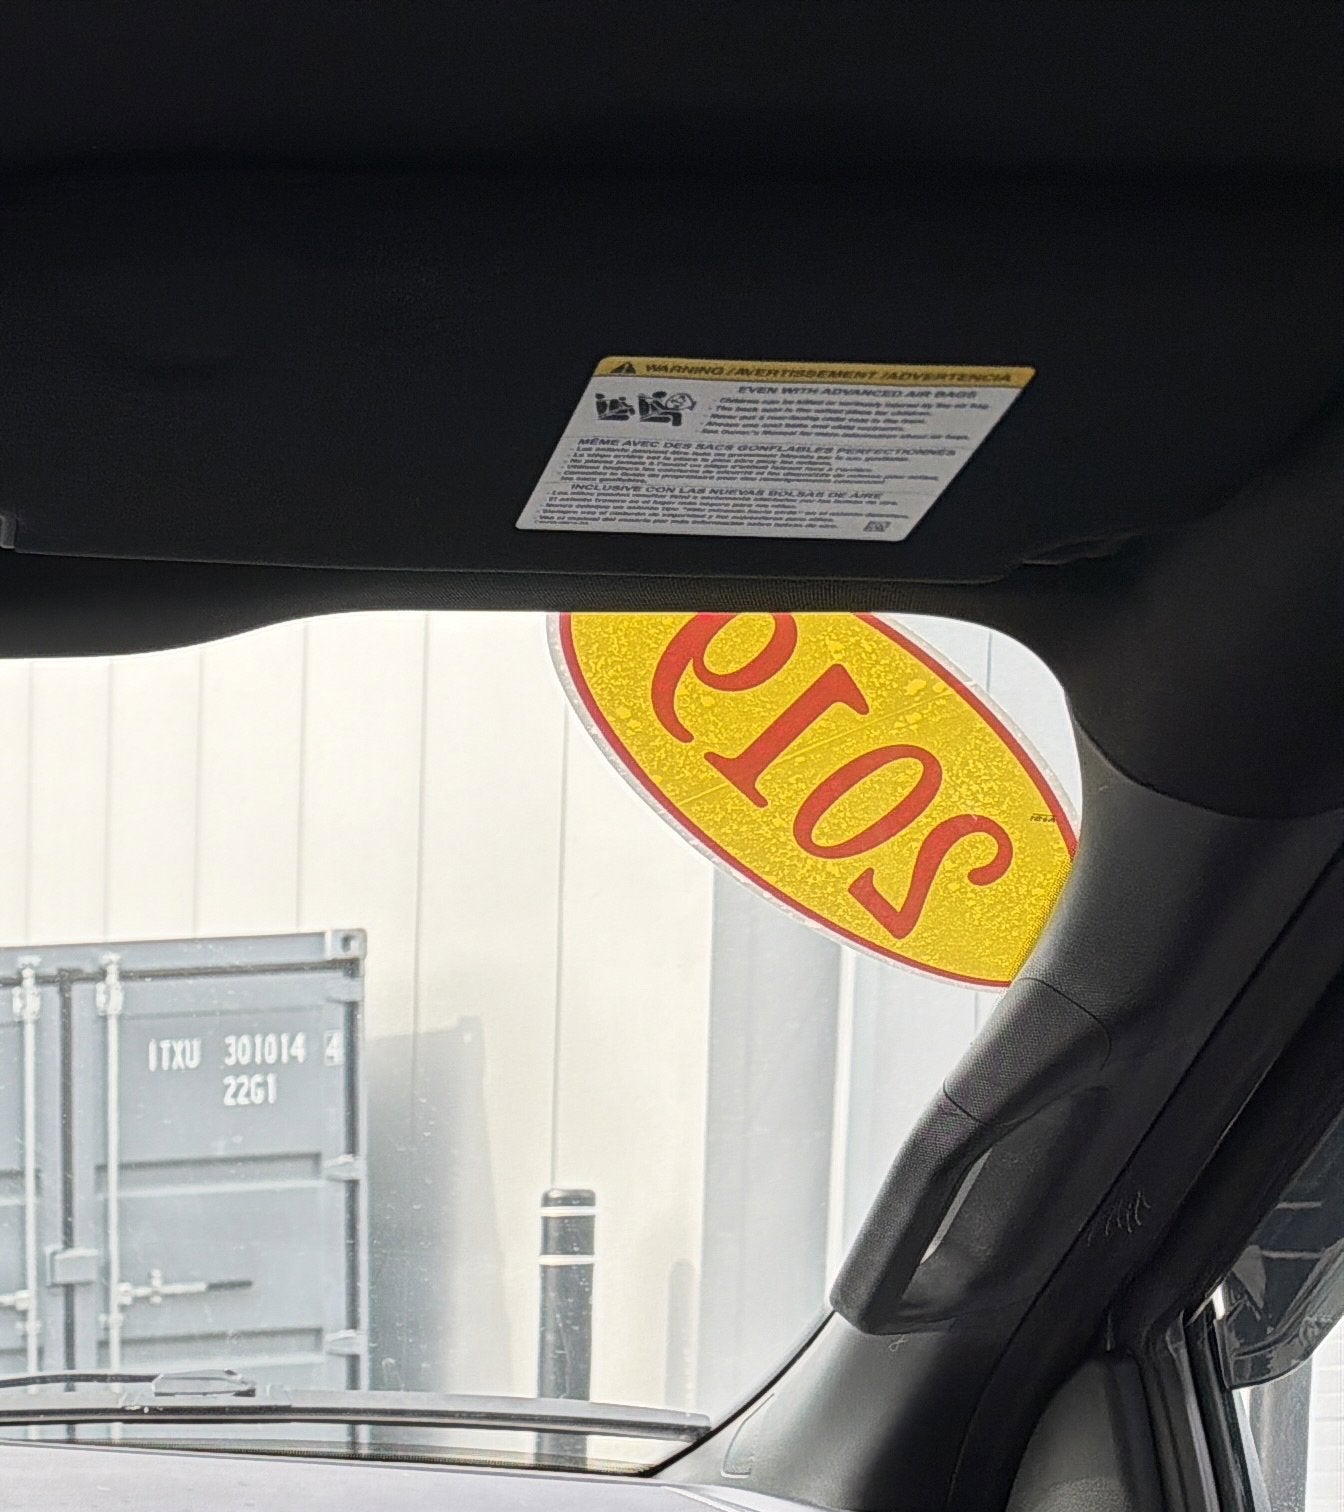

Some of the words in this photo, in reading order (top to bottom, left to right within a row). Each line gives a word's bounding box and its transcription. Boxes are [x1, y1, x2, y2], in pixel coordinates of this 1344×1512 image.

[646, 364, 724, 376] WARNING
[735, 367, 876, 380] AVERTISSEMENT
[148, 1037, 202, 1072] ITXU
[224, 1031, 307, 1066] 301014
[325, 1032, 344, 1066] 4
[222, 1073, 278, 1107] 22G1
